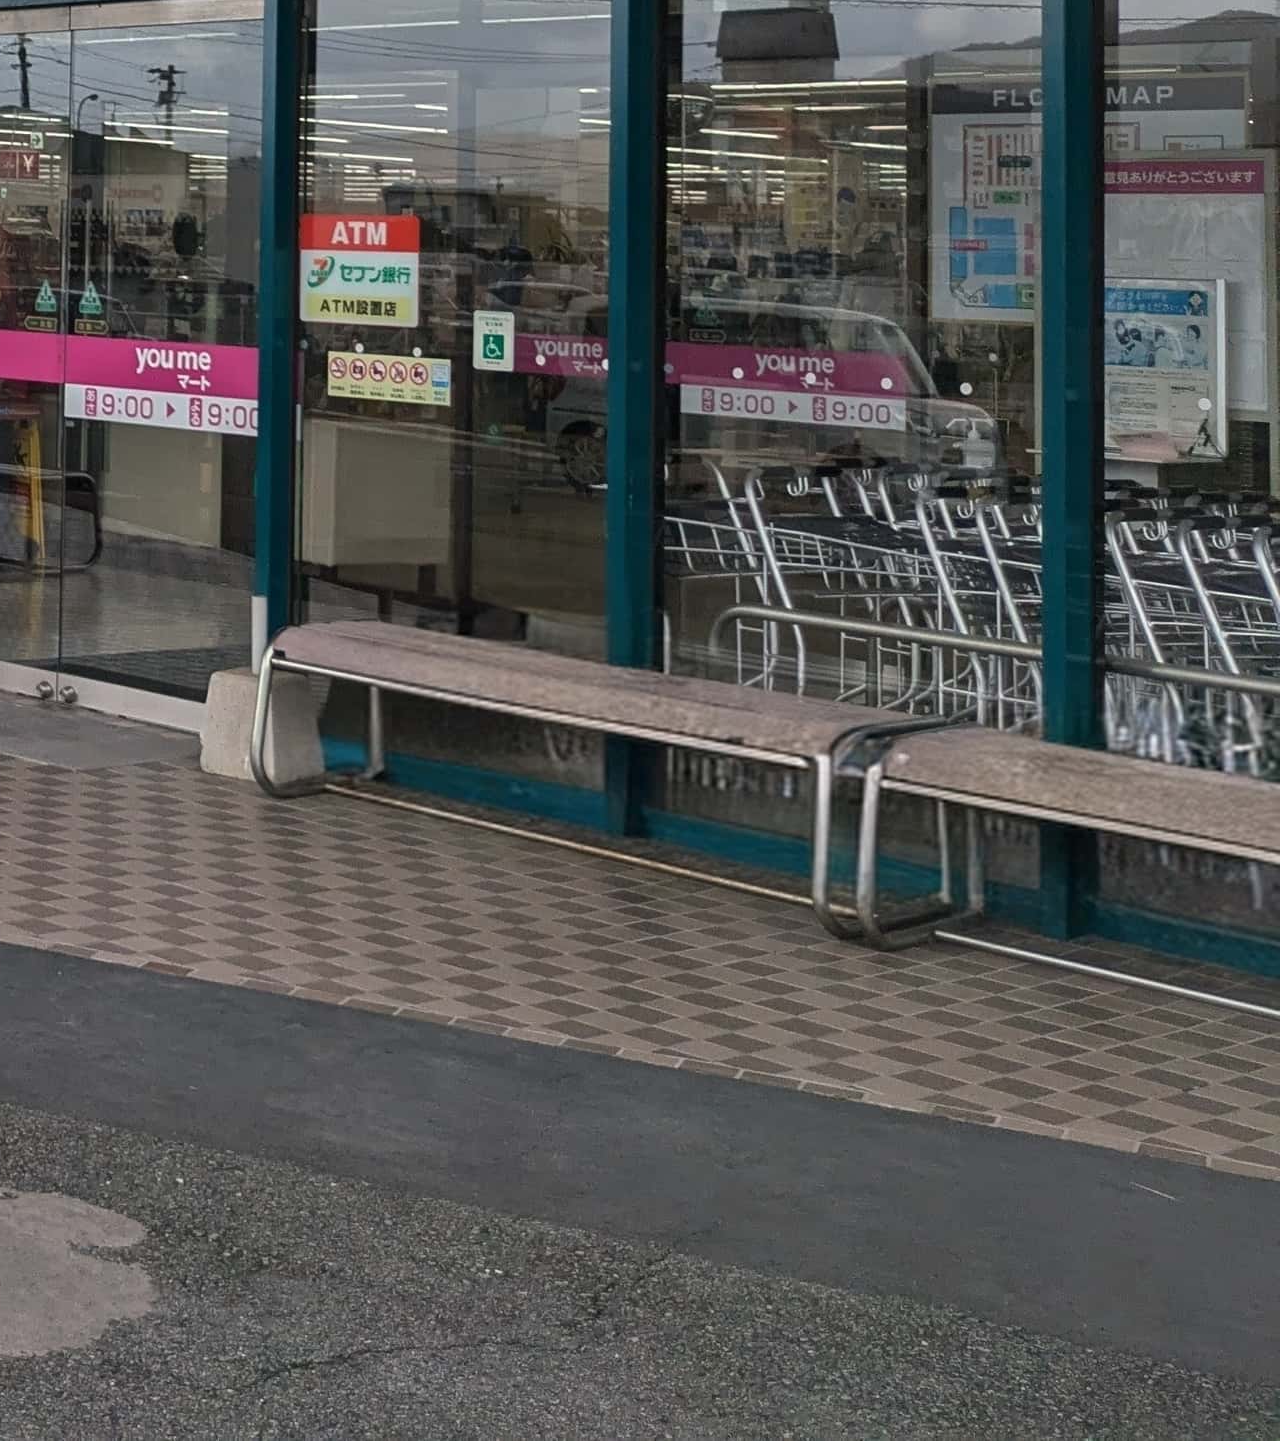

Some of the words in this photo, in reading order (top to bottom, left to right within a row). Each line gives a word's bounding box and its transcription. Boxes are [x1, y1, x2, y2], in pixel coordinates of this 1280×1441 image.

[993, 89, 1043, 106] FLO
[1106, 85, 1174, 104] MAP
[330, 221, 387, 246] ATM
[340, 264, 411, 284] セブン銀行
[320, 299, 397, 317] ATM設置店
[572, 360, 602, 375] マート
[177, 374, 211, 391] マート
[102, 394, 153, 419] 9:00
[719, 392, 775, 415] 9:00
[832, 401, 891, 424] 9:00
